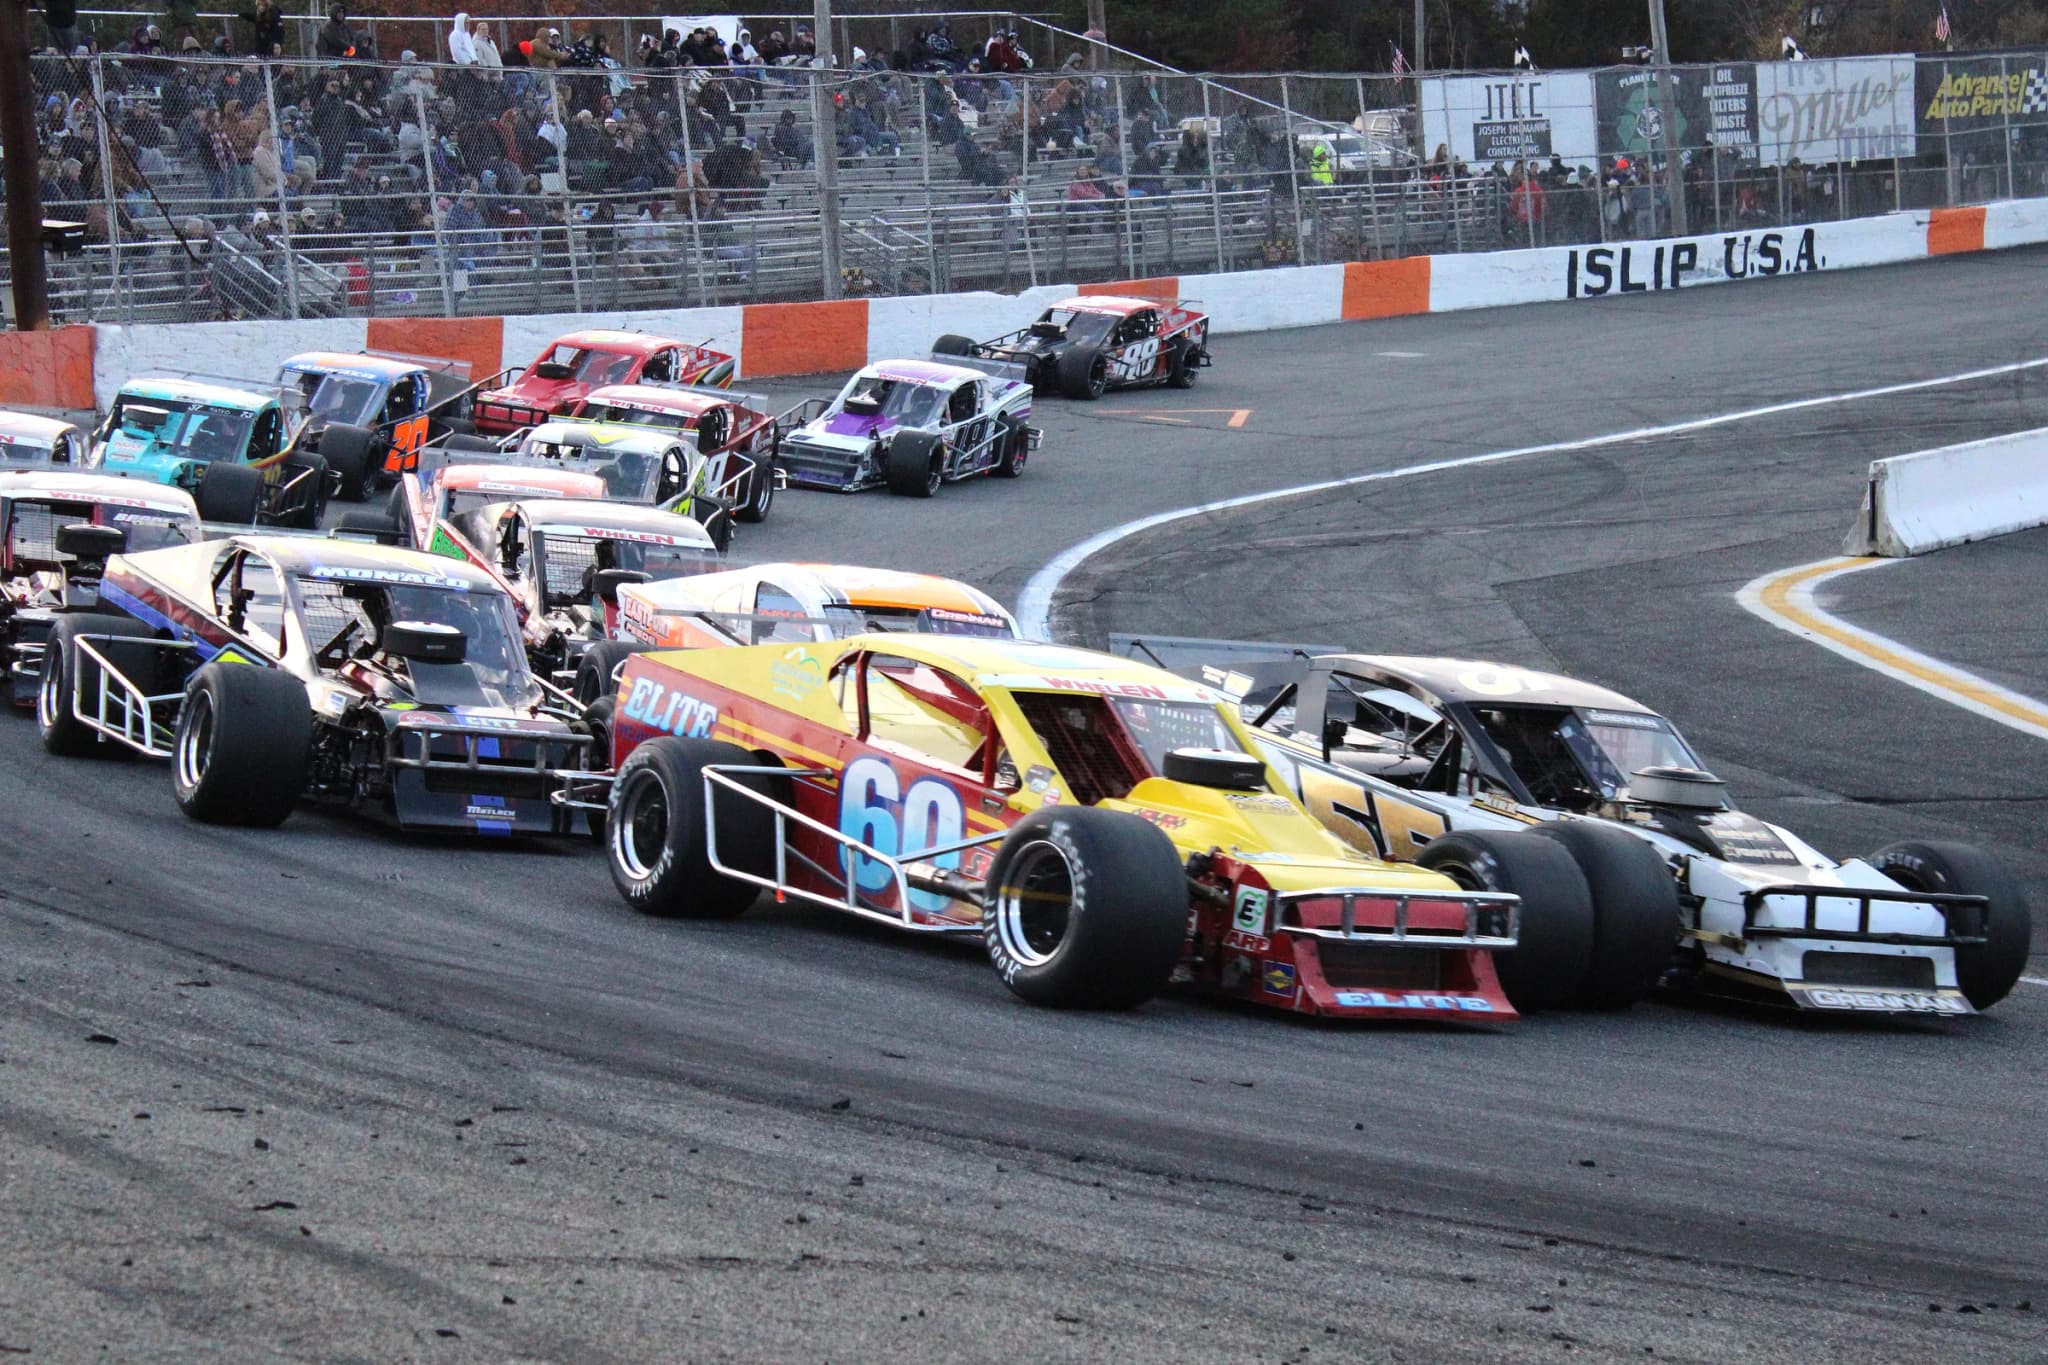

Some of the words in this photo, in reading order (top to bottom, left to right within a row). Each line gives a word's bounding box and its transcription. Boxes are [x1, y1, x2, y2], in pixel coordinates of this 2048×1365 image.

[1717, 69, 1732, 82] OIL
[1788, 63, 1826, 87] IT'S
[1937, 73, 2019, 97] Advance
[1761, 71, 1911, 158] Miller
[1925, 97, 1969, 119] Auto
[1970, 96, 2021, 117] Parts
[1492, 134, 1534, 146] ELECTRIAL
[1706, 130, 1751, 145] RMOVAL
[1842, 124, 1908, 159] TIME
[1487, 144, 1539, 157] CONTRACING
[1567, 243, 1697, 299] ISLIP
[1724, 228, 1826, 279] U.S.A.
[878, 372, 928, 385] WHELEN
[609, 399, 665, 413] WHELEN
[382, 416, 429, 472] 20
[50, 490, 147, 508] WHELEN
[583, 527, 675, 545] WHELEN
[624, 597, 669, 639] EASTORT
[931, 608, 1004, 627] GRENNAN
[1041, 676, 1167, 700] WHELEN
[624, 676, 718, 738] ELITE
[837, 755, 966, 914] 60
[1334, 992, 1494, 1012] ELITE
[1813, 988, 1964, 1012] GRENNAN
